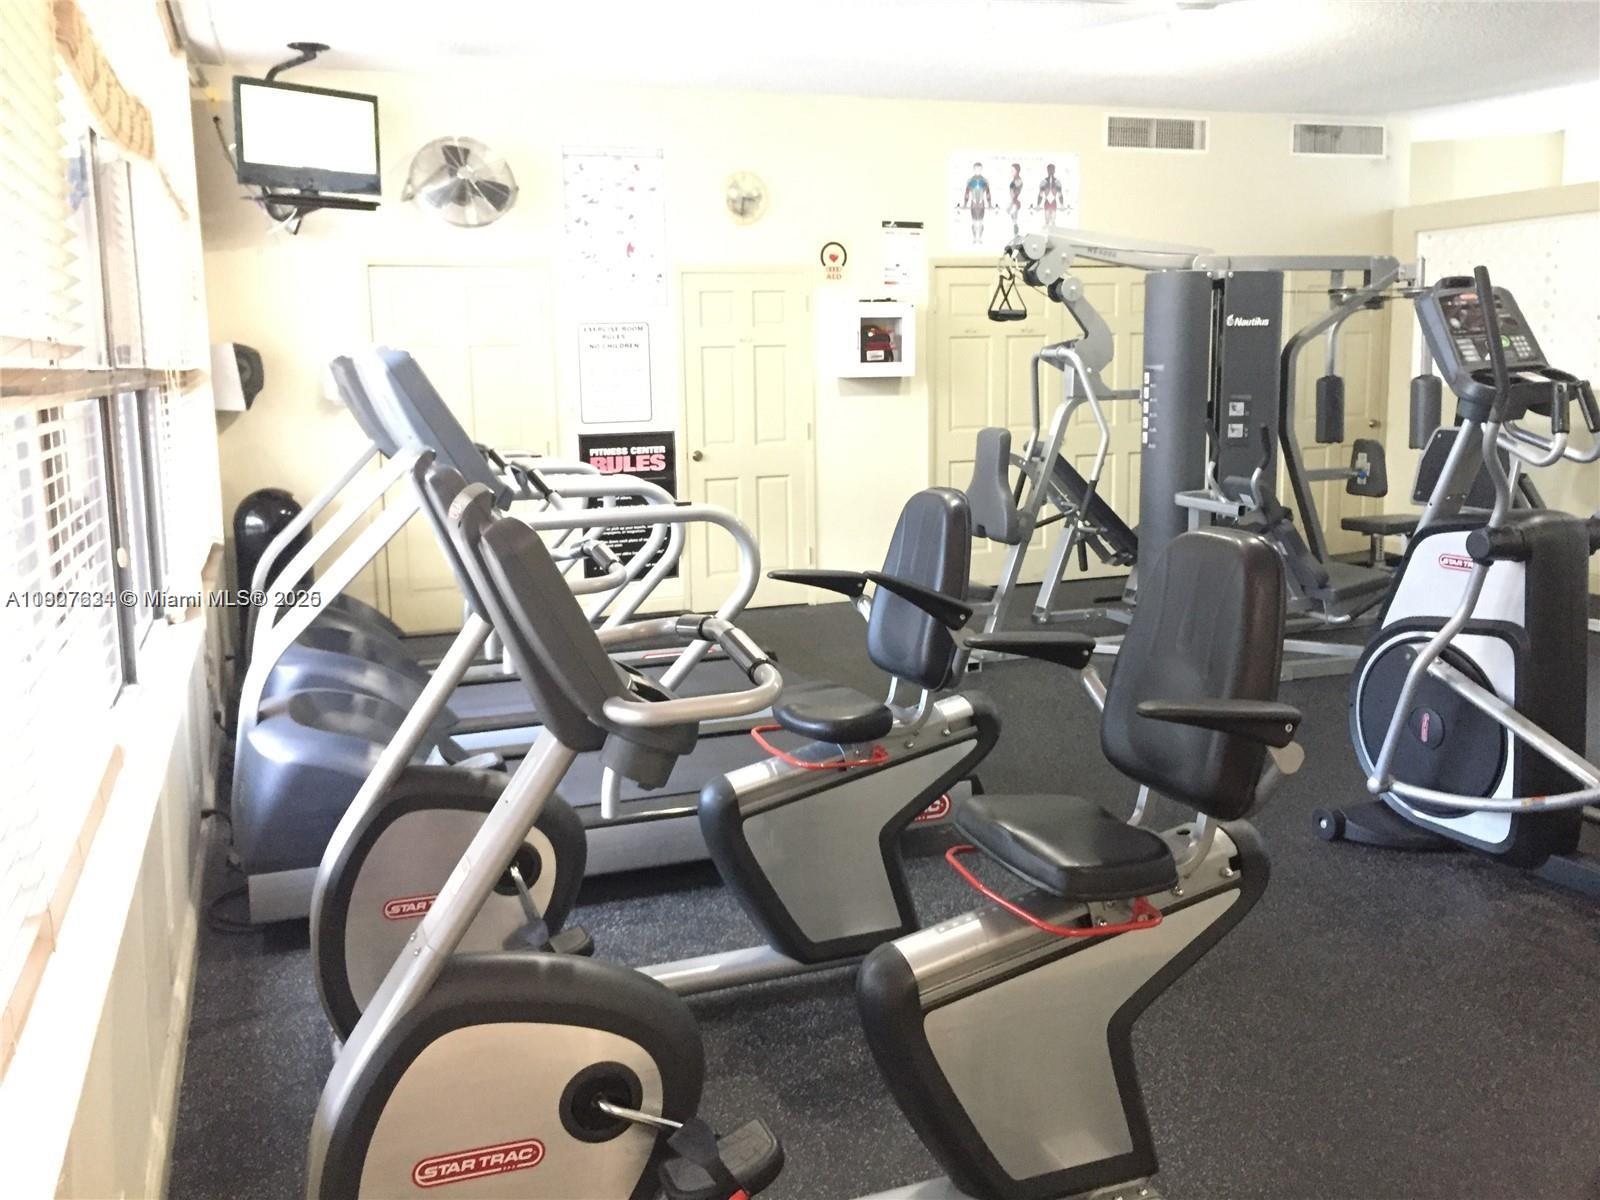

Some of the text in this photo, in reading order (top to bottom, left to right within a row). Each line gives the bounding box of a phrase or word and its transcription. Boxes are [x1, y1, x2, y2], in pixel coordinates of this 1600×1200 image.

[1234, 316, 1270, 327] Nautilus
[589, 446, 666, 456] FITNESS CENTER
[590, 454, 666, 474] RULES
[389, 902, 427, 914] STAR
[420, 1147, 533, 1179] STAR TRAC
